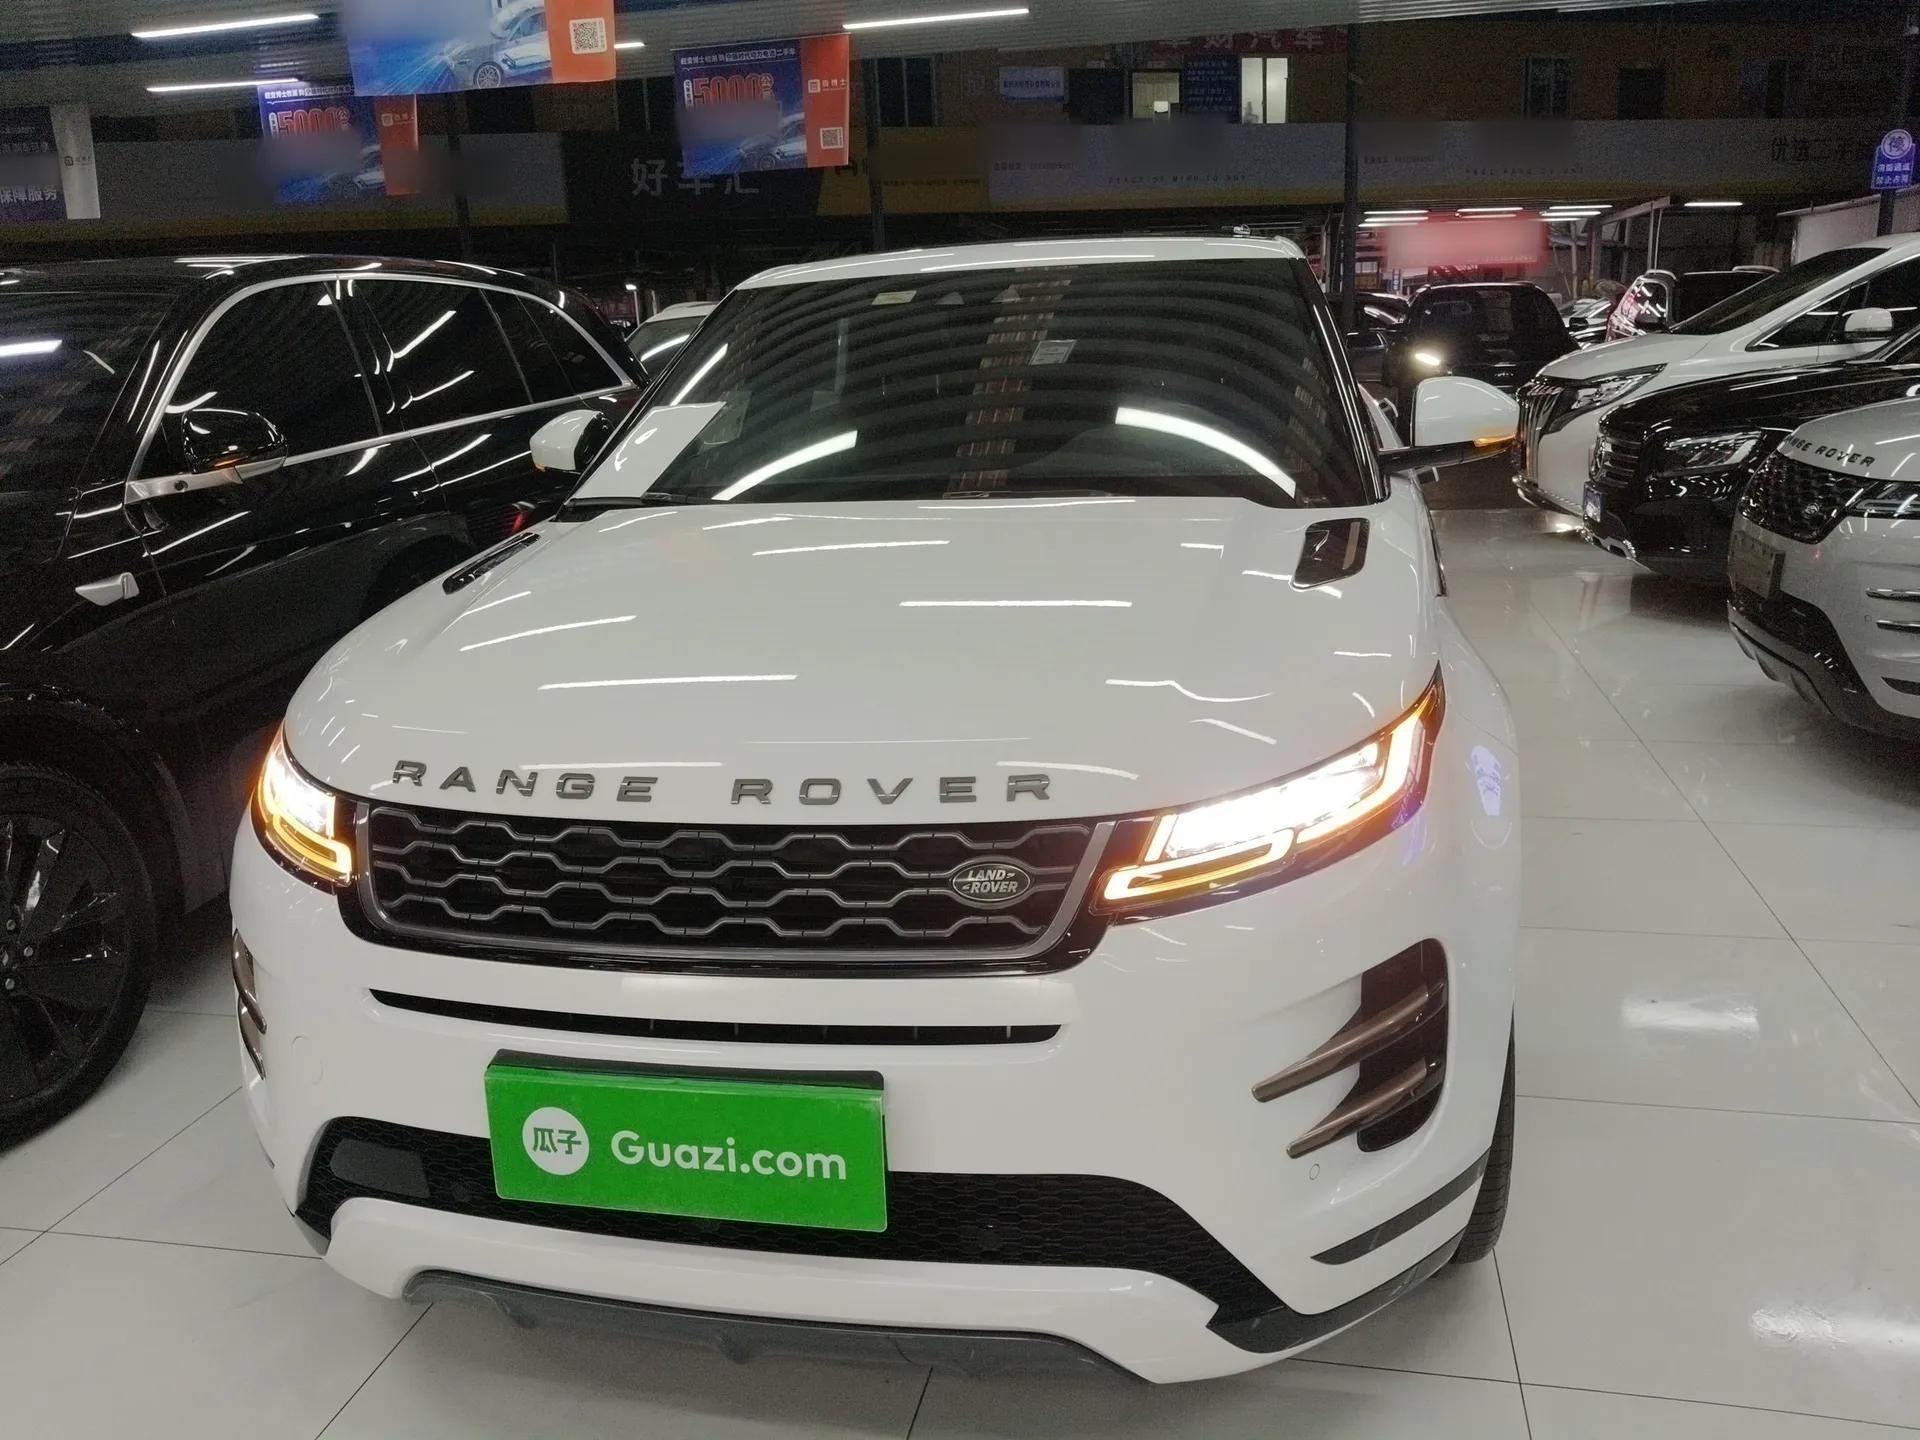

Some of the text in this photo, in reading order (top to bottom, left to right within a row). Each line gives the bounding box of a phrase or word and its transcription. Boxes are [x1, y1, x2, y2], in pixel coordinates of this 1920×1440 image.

[1814, 444, 1876, 467] ROVER
[391, 759, 1050, 805] RANGE ROVER
[967, 869, 1007, 881] LAND
[970, 881, 1018, 894] ROVER
[532, 1126, 582, 1156] 瓜子
[610, 1129, 847, 1181] Guazi.com
